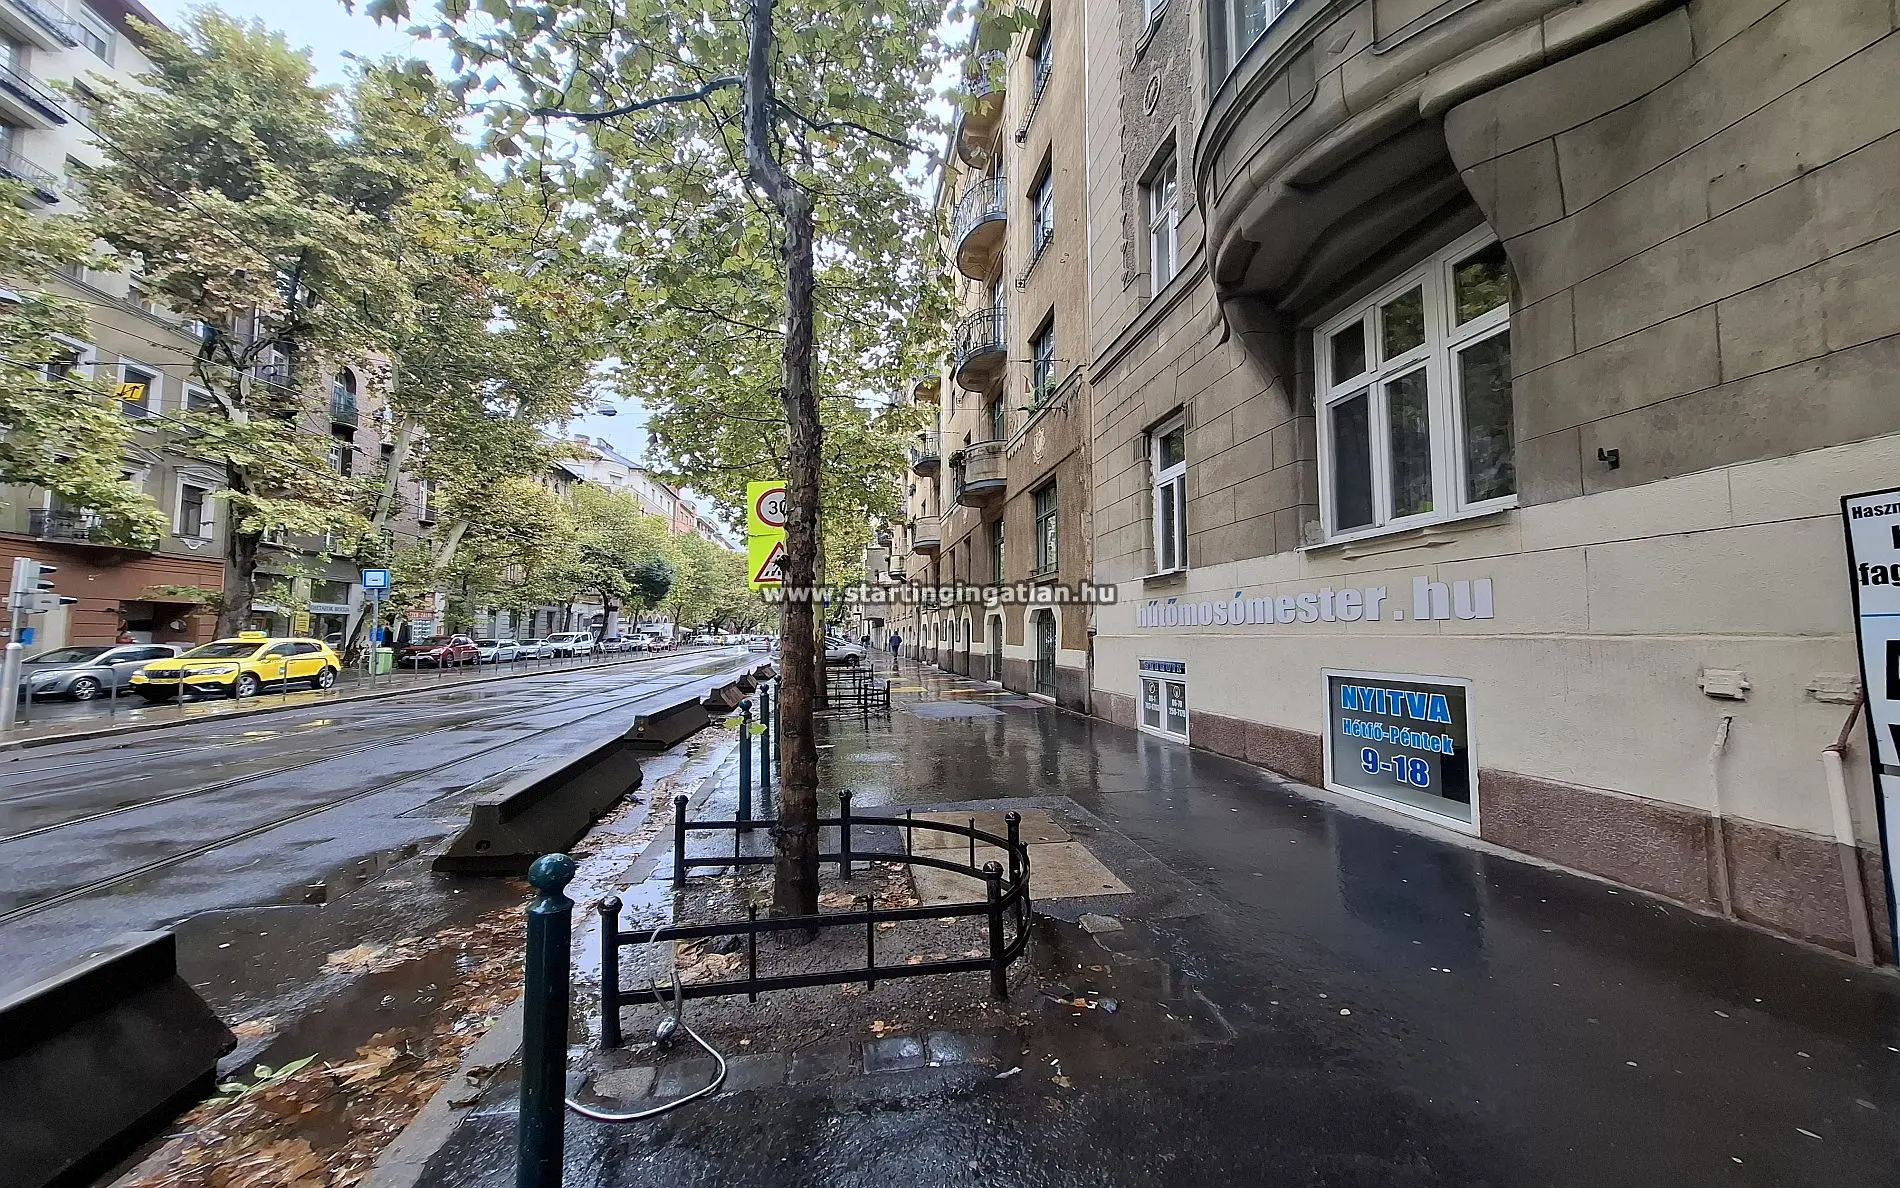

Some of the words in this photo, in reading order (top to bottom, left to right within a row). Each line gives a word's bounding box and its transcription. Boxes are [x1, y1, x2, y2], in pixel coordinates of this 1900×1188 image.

[1340, 684, 1452, 724] NYITVA
[1342, 718, 1455, 756] Hétfő-Péntek
[1361, 746, 1430, 788] 9-18
